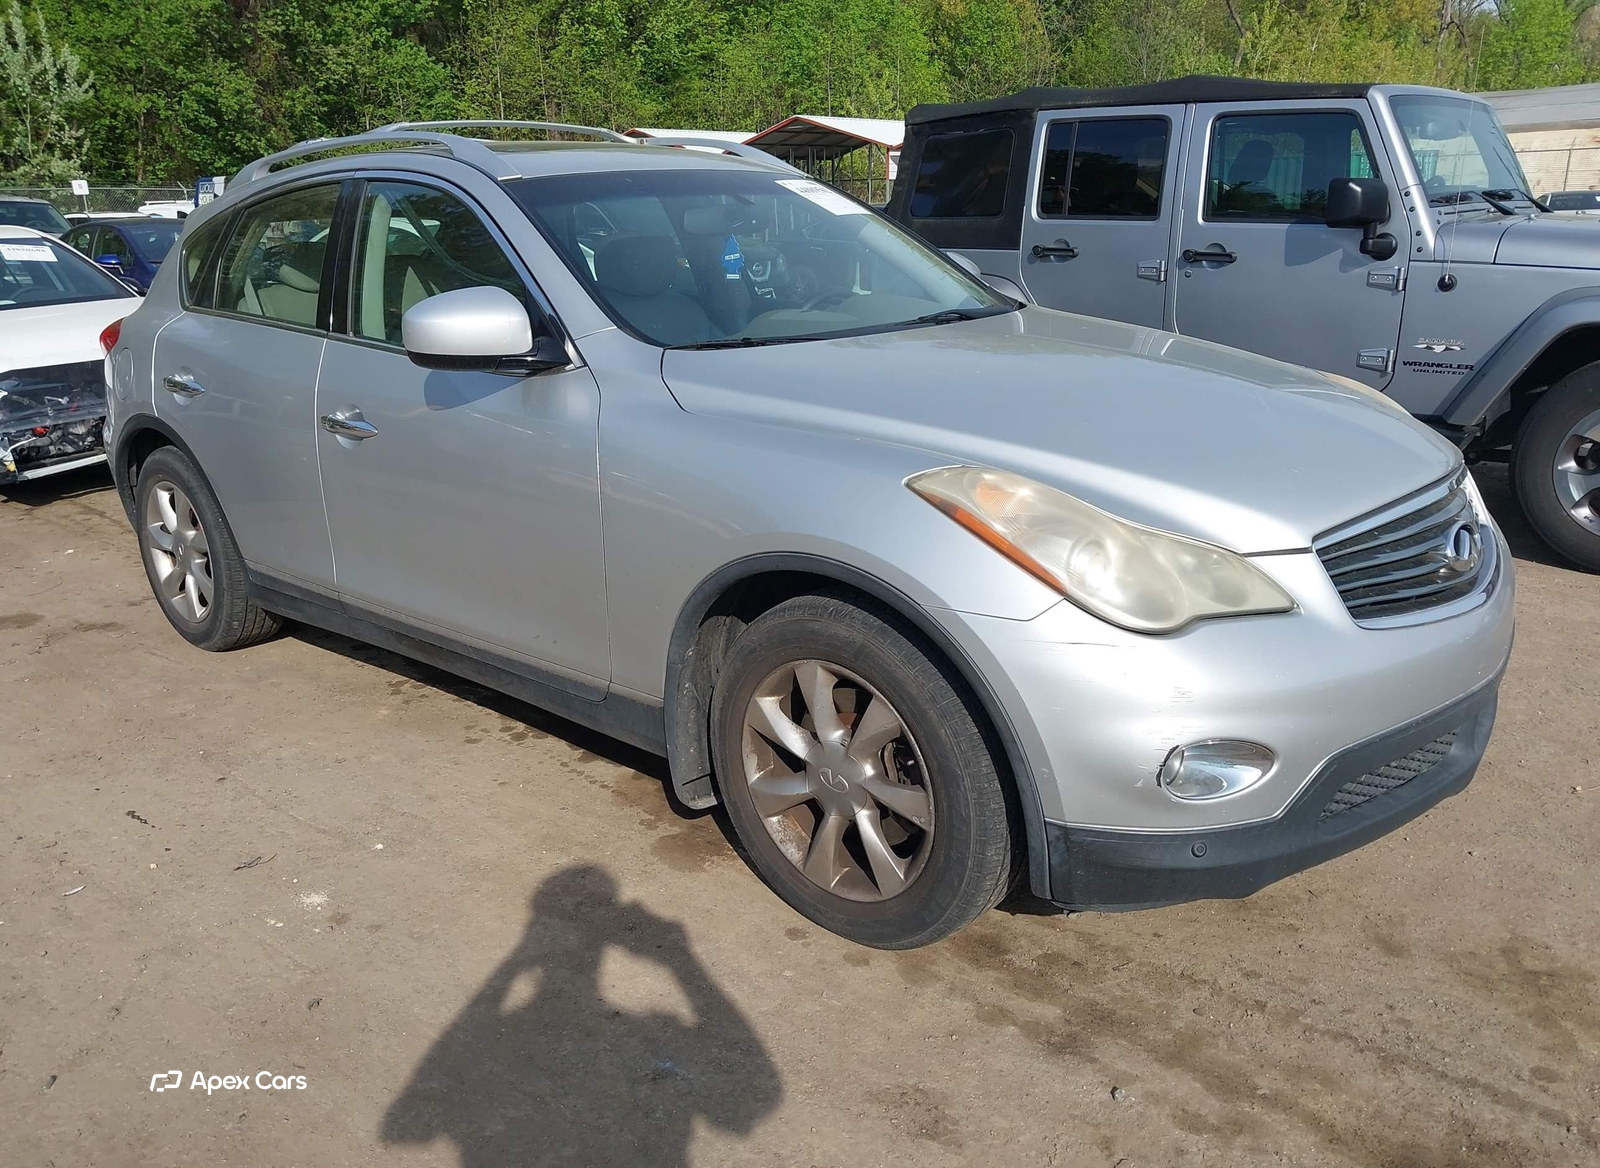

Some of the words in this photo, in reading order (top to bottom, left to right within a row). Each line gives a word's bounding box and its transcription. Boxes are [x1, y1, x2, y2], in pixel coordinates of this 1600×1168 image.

[1418, 337, 1465, 346] SAHARA
[1402, 360, 1475, 371] WRANGLER
[1412, 368, 1465, 376] UNLIMITED
